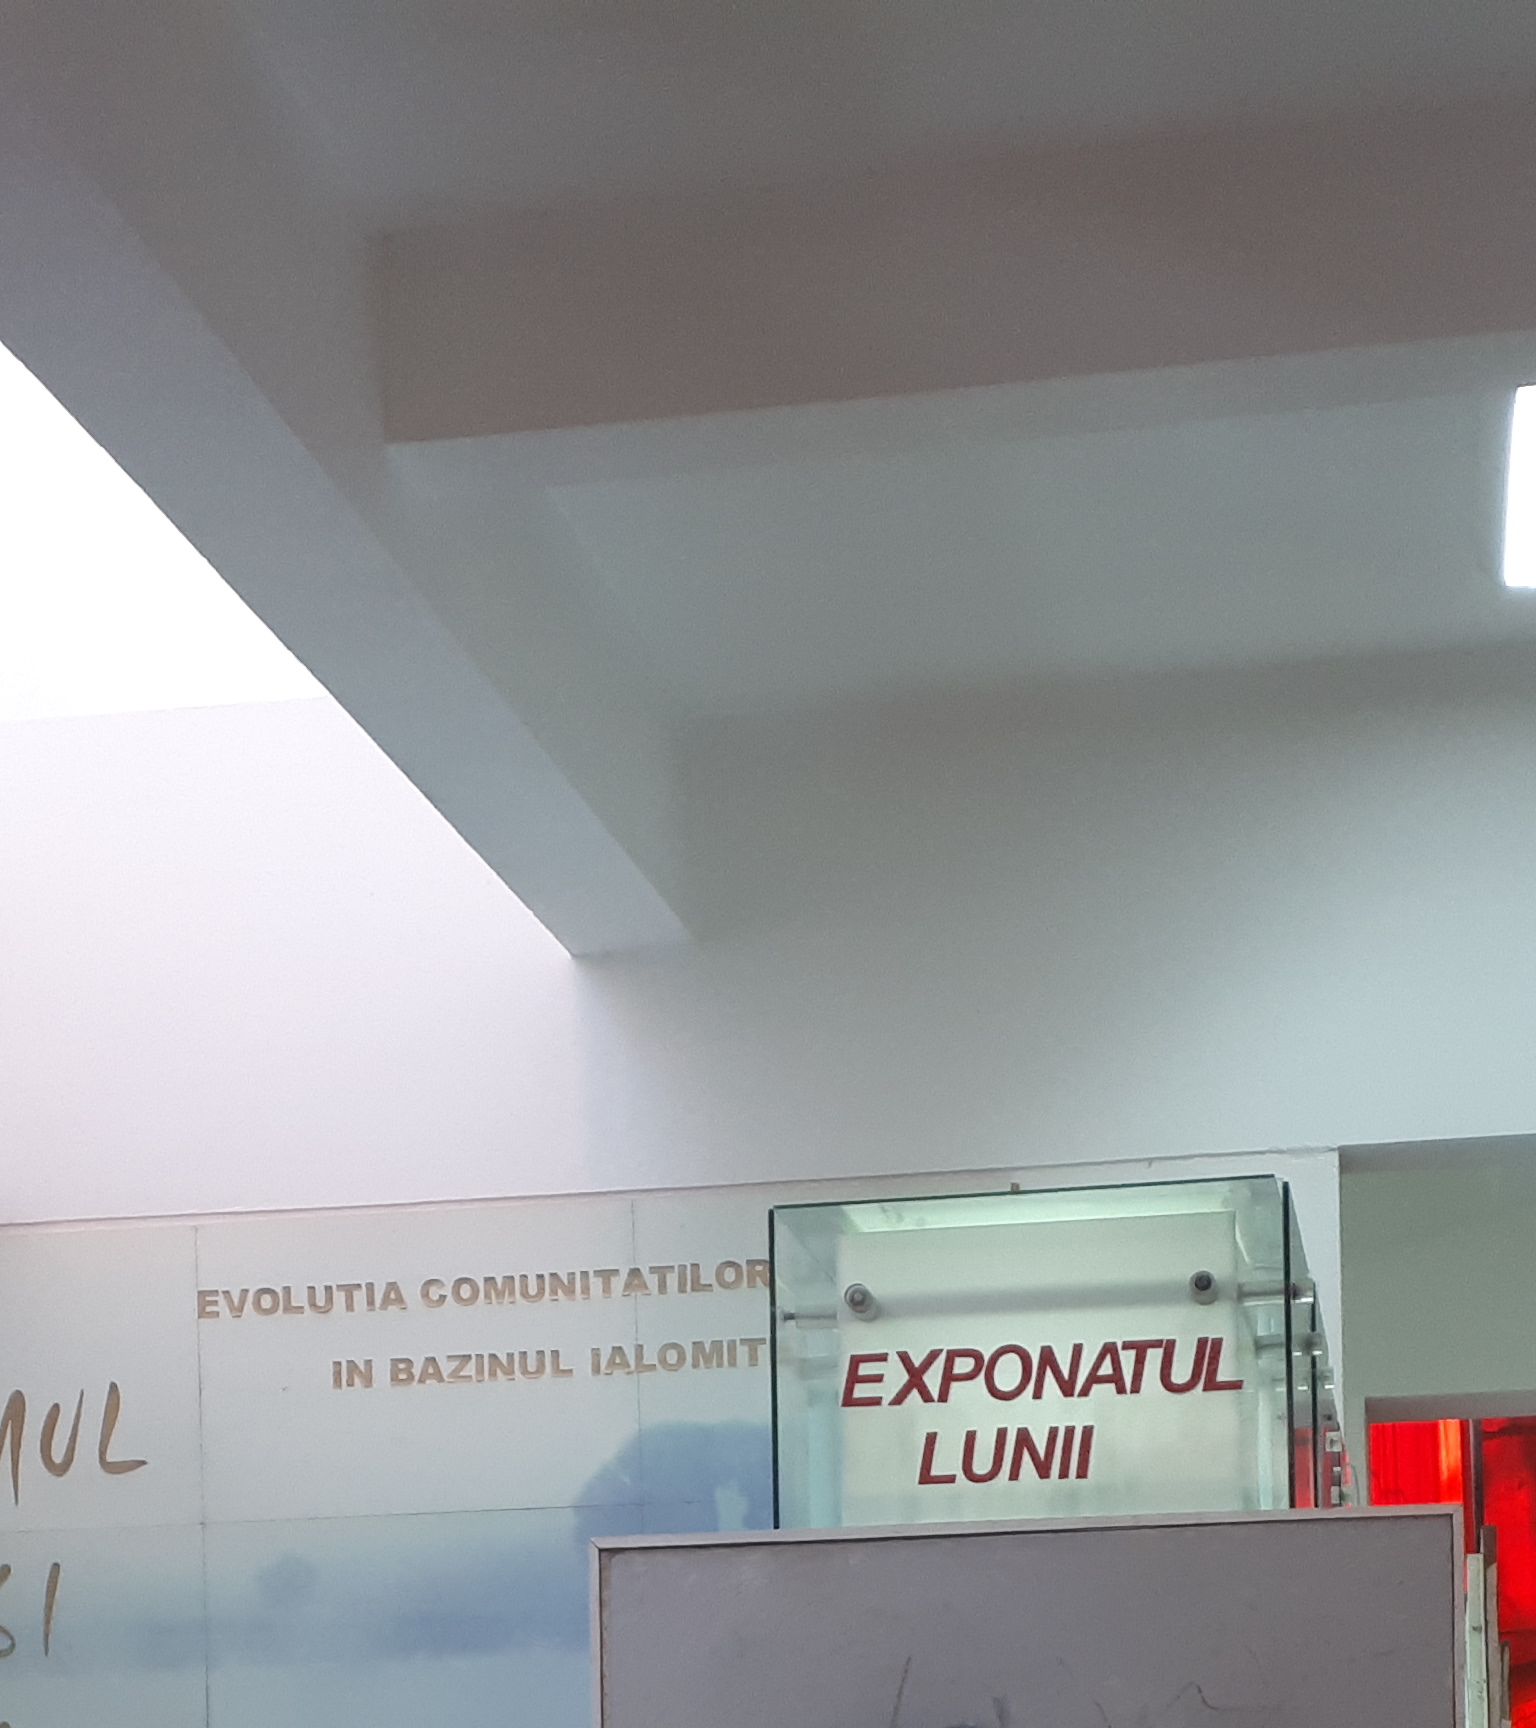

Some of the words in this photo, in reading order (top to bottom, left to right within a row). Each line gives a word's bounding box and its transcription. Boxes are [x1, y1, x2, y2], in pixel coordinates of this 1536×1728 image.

[197, 1280, 408, 1320] EVOLUTIA
[420, 1258, 771, 1309] COMUNITATILOR
[332, 1360, 373, 1390] IN
[390, 1349, 574, 1388] BAZINUL
[841, 1337, 1245, 1407] EXPONATUL
[918, 1425, 1094, 1485] LUNII
